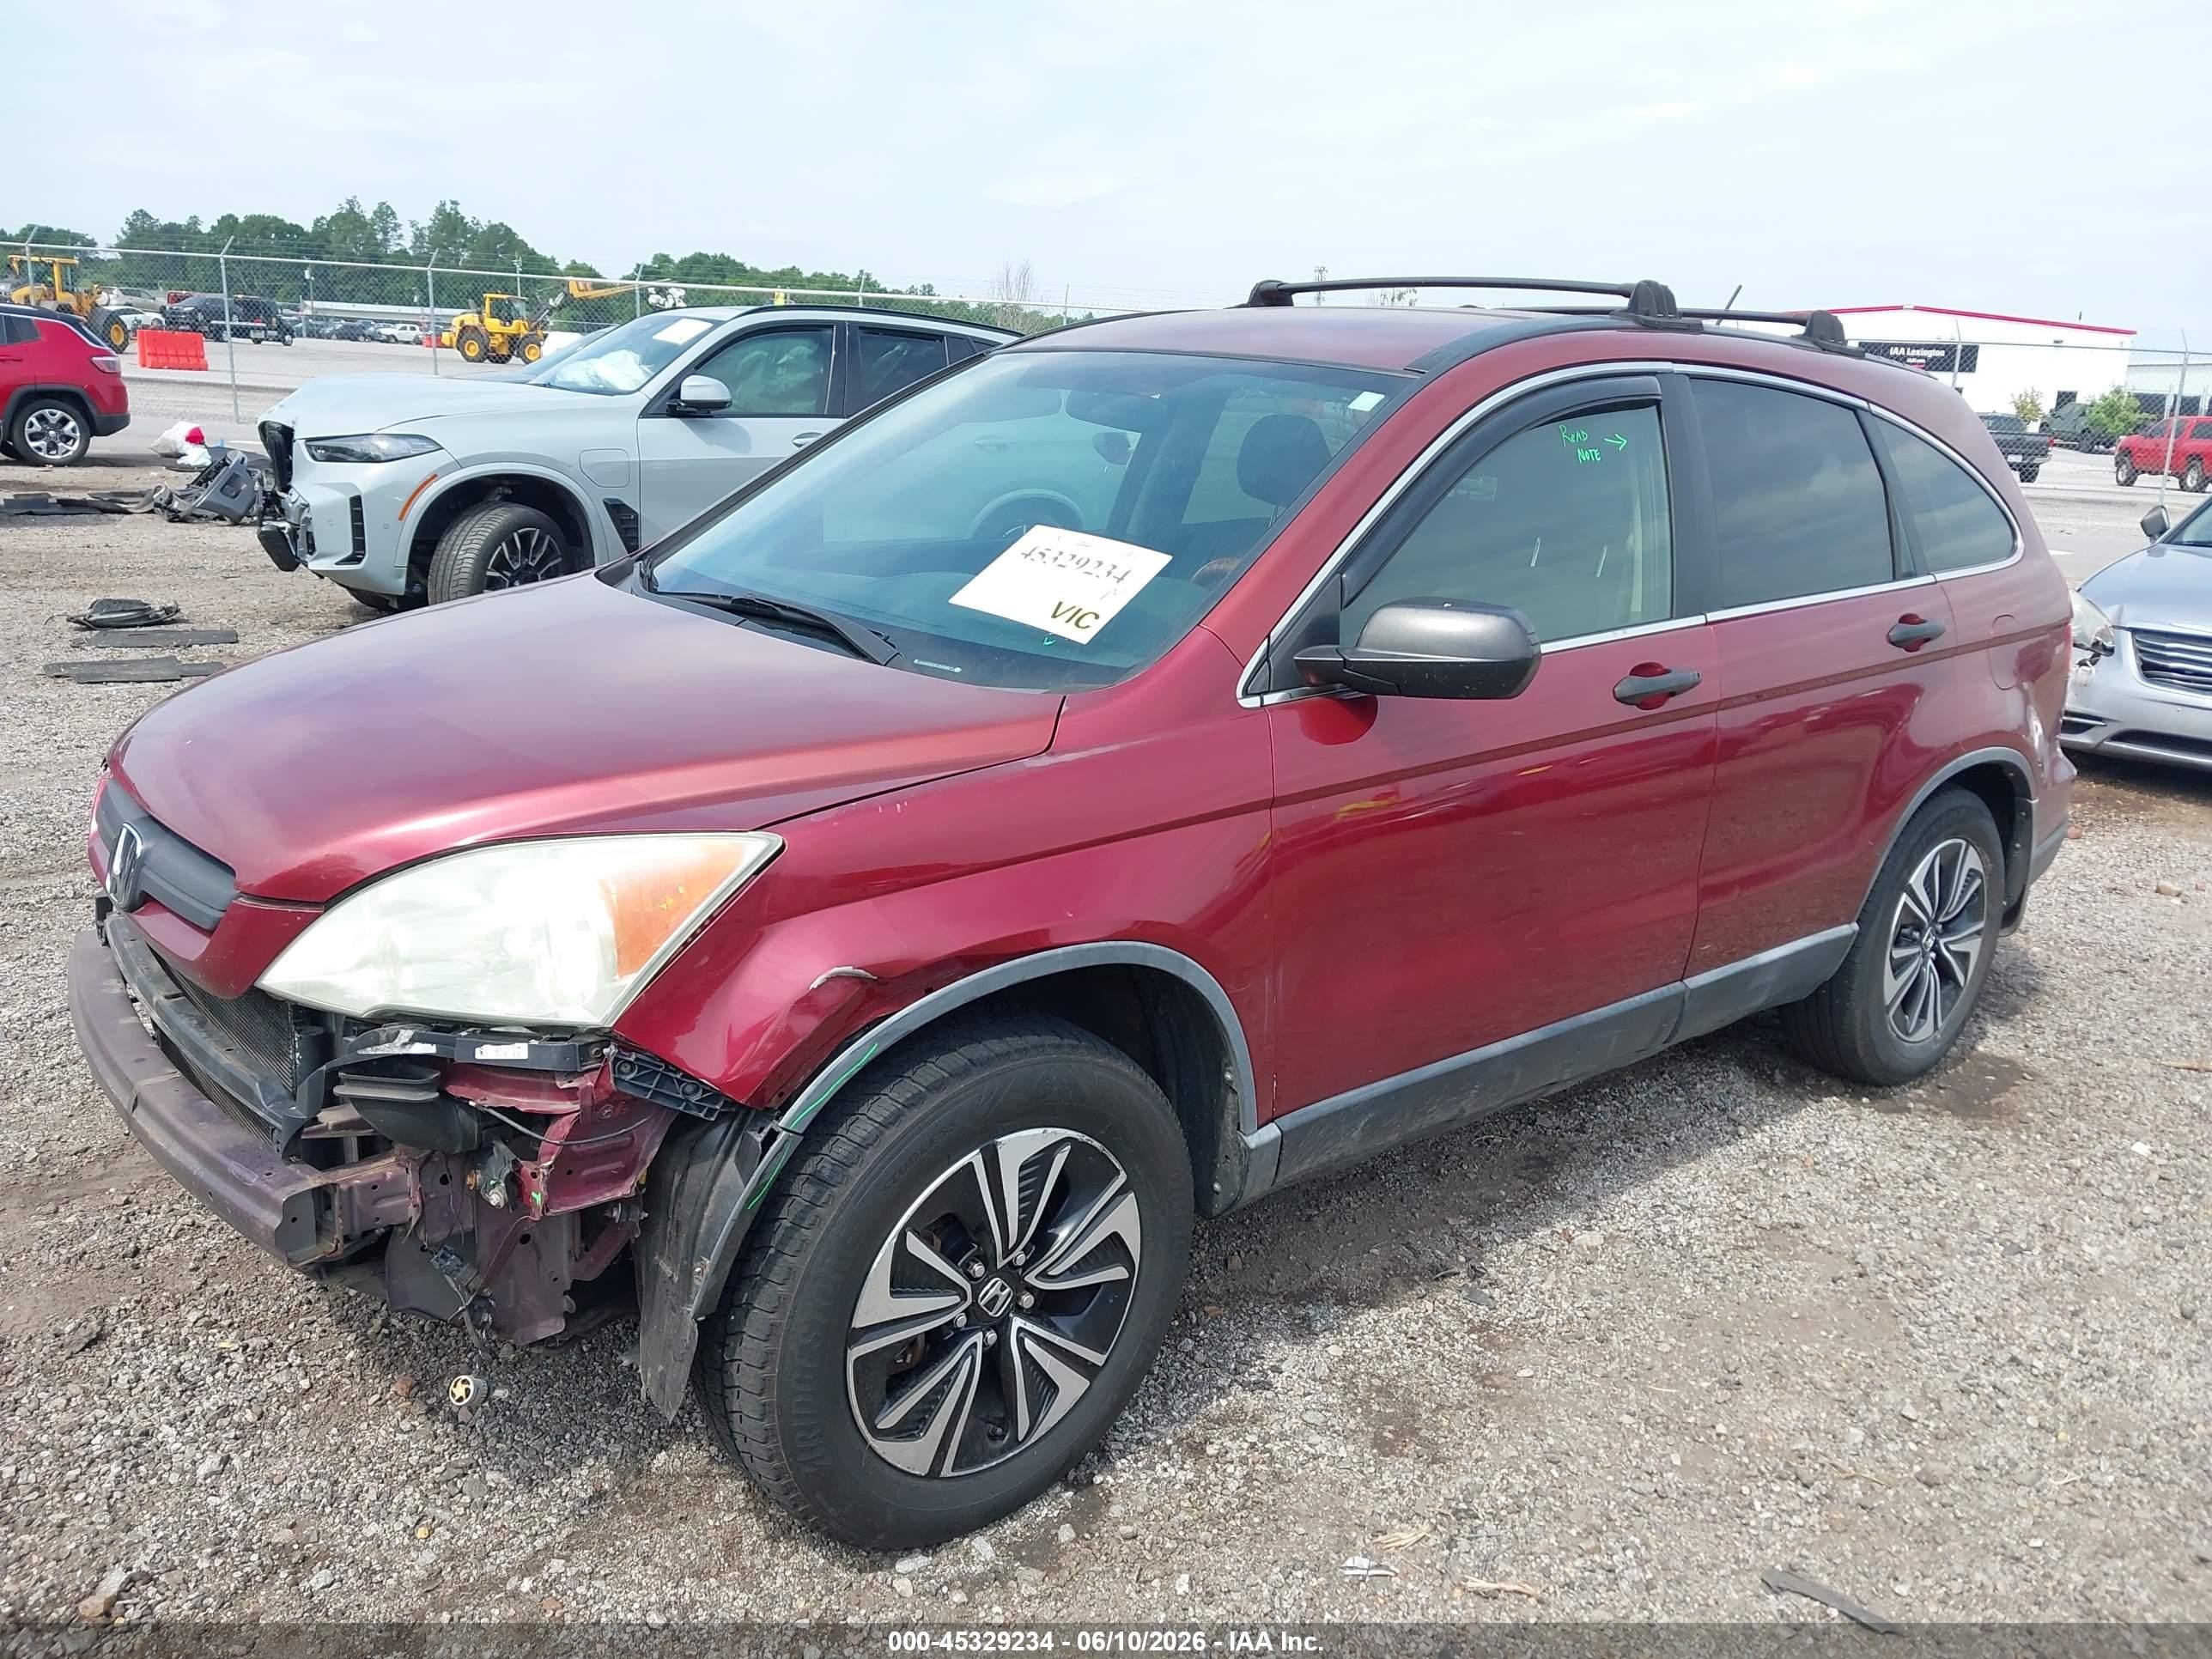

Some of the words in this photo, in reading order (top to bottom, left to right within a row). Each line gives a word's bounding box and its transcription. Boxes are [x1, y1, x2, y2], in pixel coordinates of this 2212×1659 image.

[1889, 346, 1905, 356] IAA
[1020, 545, 1133, 584] 45329234
[1050, 600, 1101, 629] VIC
